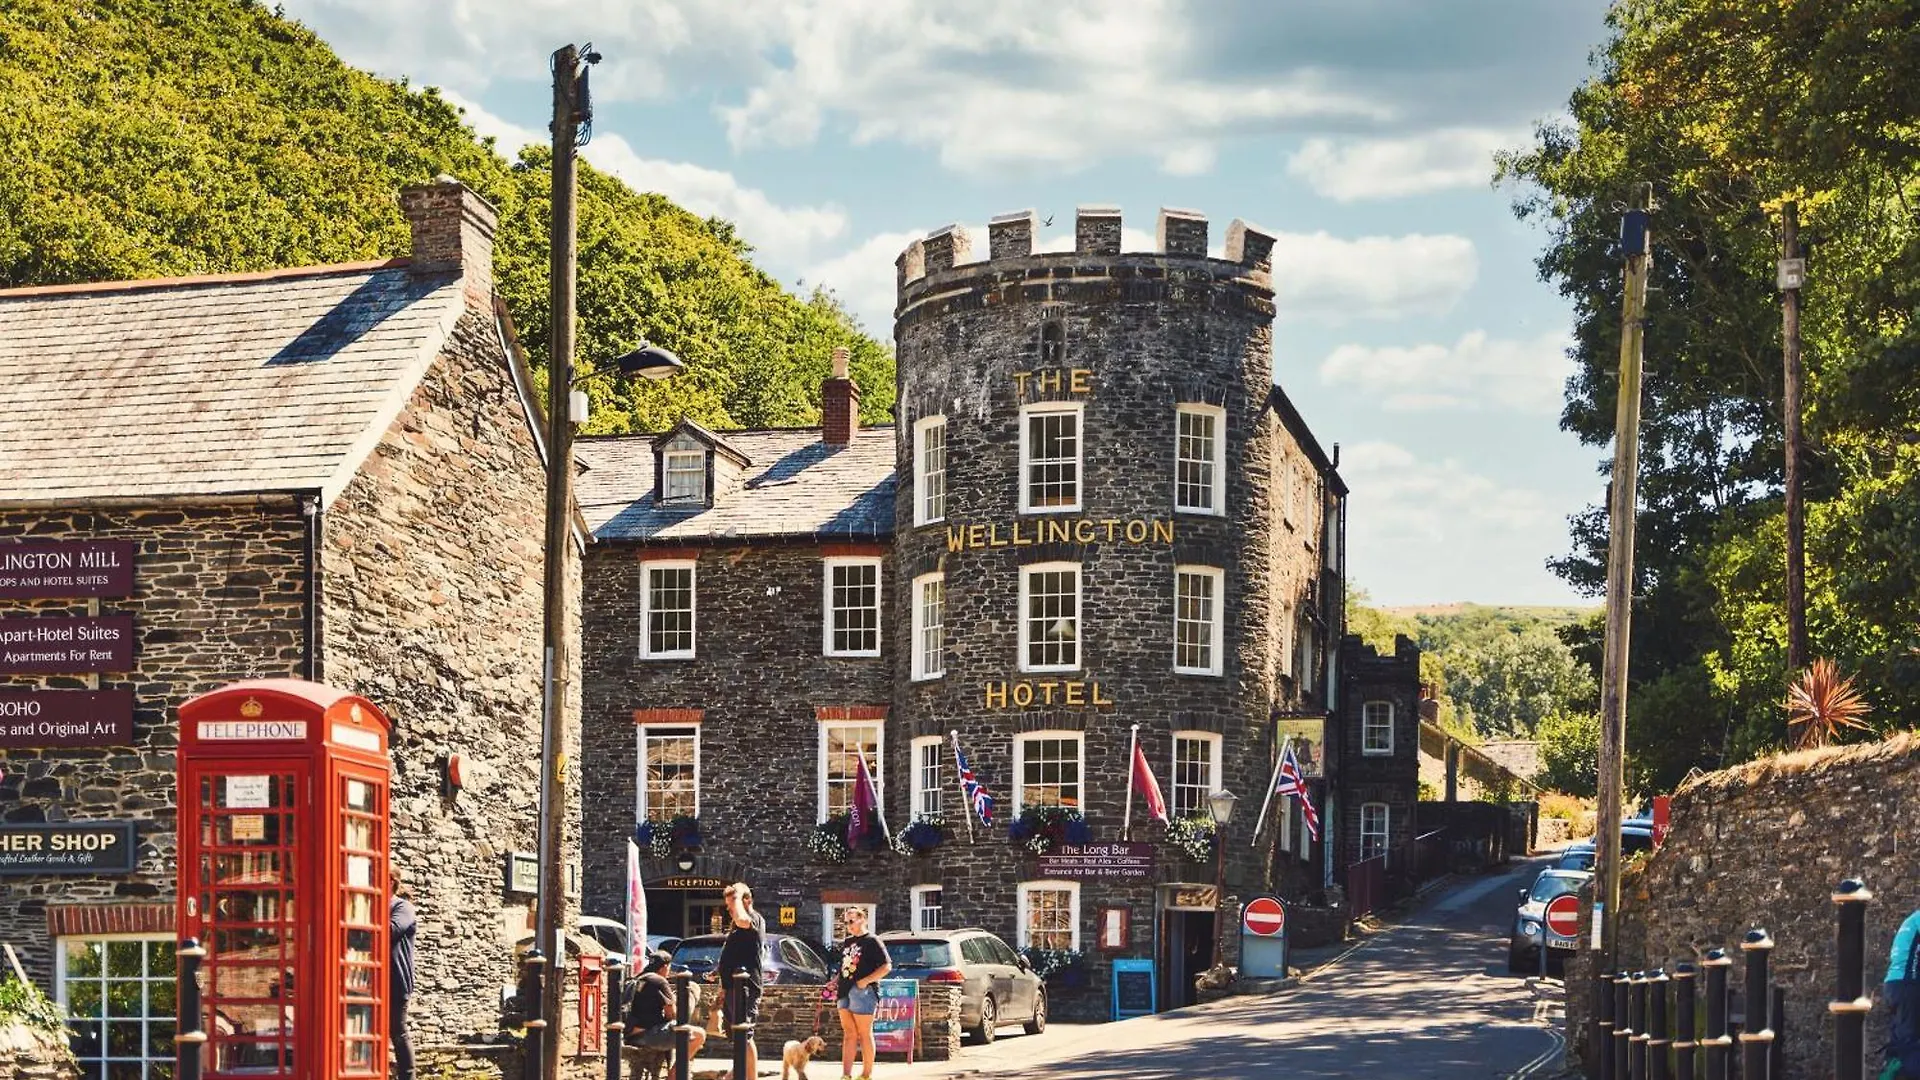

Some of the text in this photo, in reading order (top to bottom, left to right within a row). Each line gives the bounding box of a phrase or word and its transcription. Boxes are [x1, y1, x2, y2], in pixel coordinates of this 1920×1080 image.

[1013, 368, 1092, 395] THE
[946, 519, 1174, 552] WELLINGTON
[79, 551, 120, 568] MILL
[20, 577, 41, 586] AND
[43, 576, 74, 586] HOTEL
[76, 575, 109, 585] SUITES
[77, 626, 120, 640] Suites
[4, 649, 113, 664] Apartments For Rent
[986, 681, 1113, 708] HOTEL
[10, 722, 34, 735] and
[39, 721, 89, 738] Original
[93, 721, 117, 734] Art
[204, 723, 302, 738] TELEPHONE
[50, 833, 116, 851] SHOP
[1061, 844, 1130, 857] The Long Bar
[667, 879, 721, 887] RECEPTION
[782, 911, 793, 920] AA
